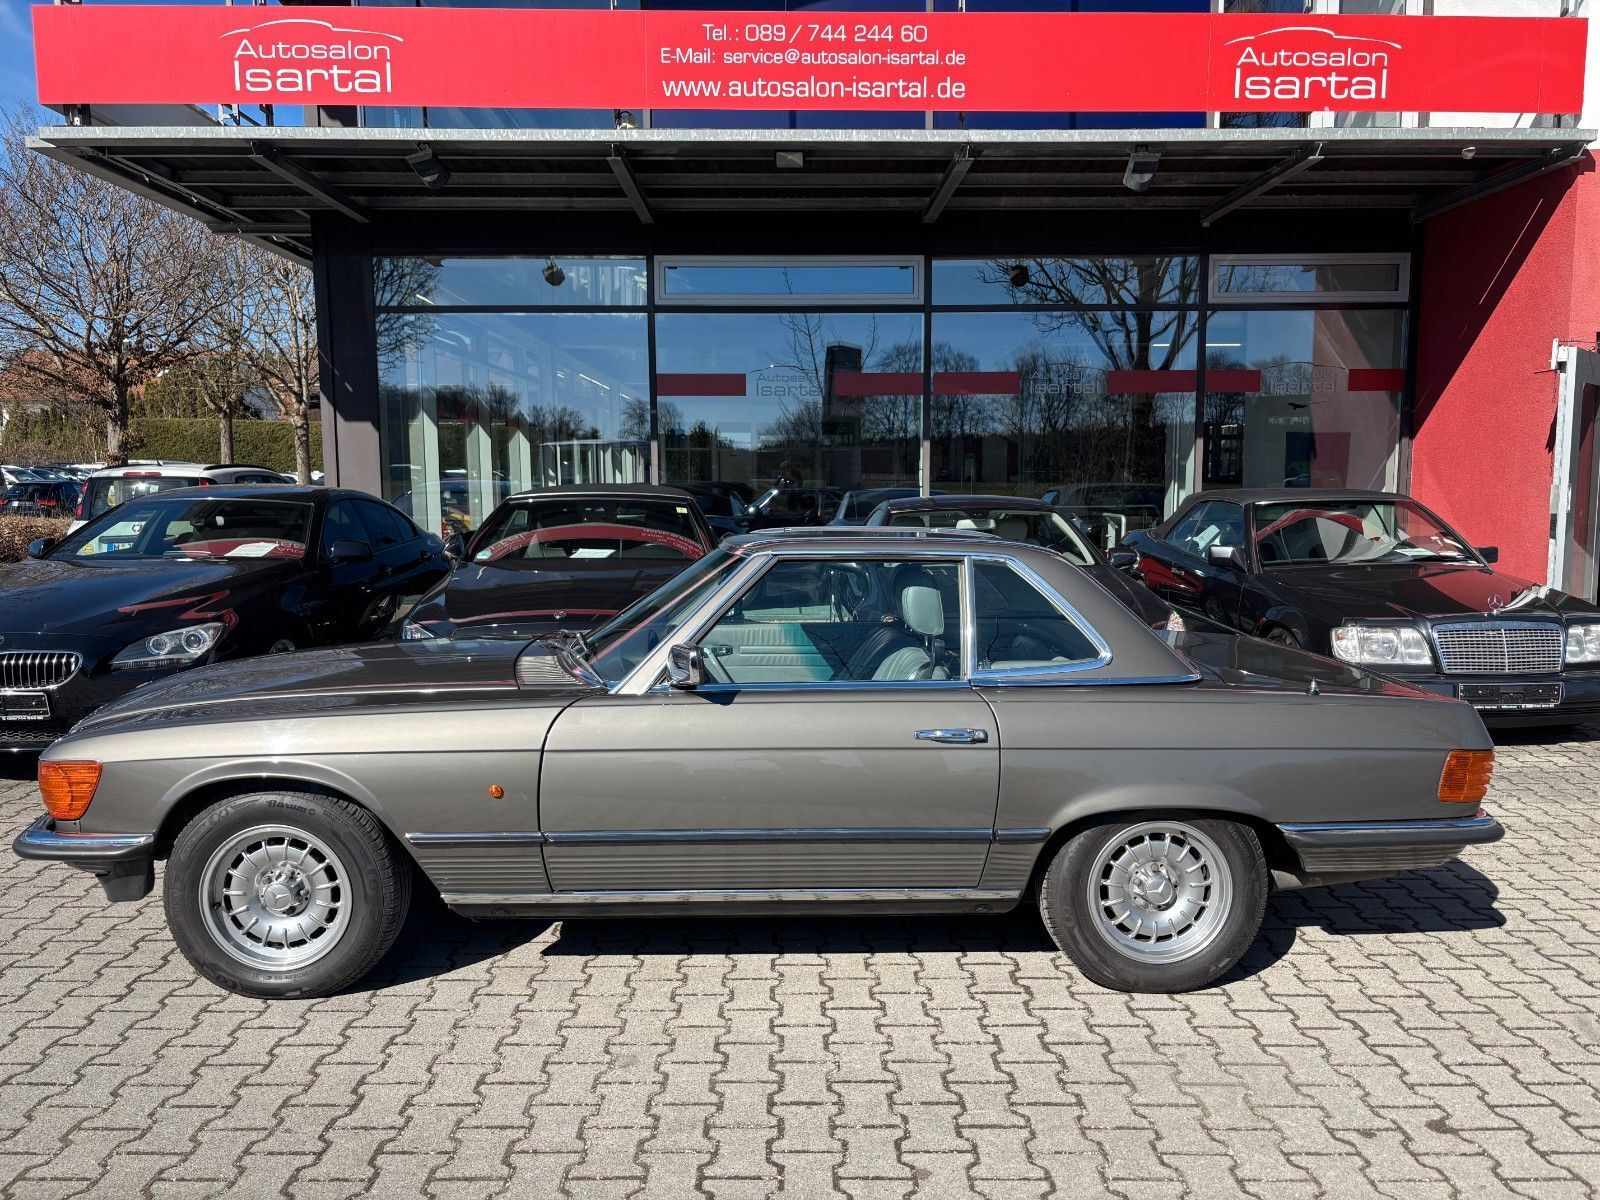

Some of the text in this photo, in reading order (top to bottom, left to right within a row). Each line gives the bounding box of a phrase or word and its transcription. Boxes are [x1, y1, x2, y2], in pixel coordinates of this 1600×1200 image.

[702, 23, 928, 43] Tel.: 089 / 744 244 60
[234, 39, 391, 60] Autosalon
[660, 47, 966, 66] E-Mail: service@autosalon-isartal.de
[1236, 47, 1388, 67] Autosalon
[233, 60, 393, 93] Isartal
[1234, 68, 1388, 99] Isartal
[662, 76, 966, 99] www.autosalon-isartal.de
[756, 373, 824, 382] Autosao
[1030, 380, 1099, 394] Isartal
[756, 382, 824, 396] Isarta
[265, 799, 308, 814] Barum
